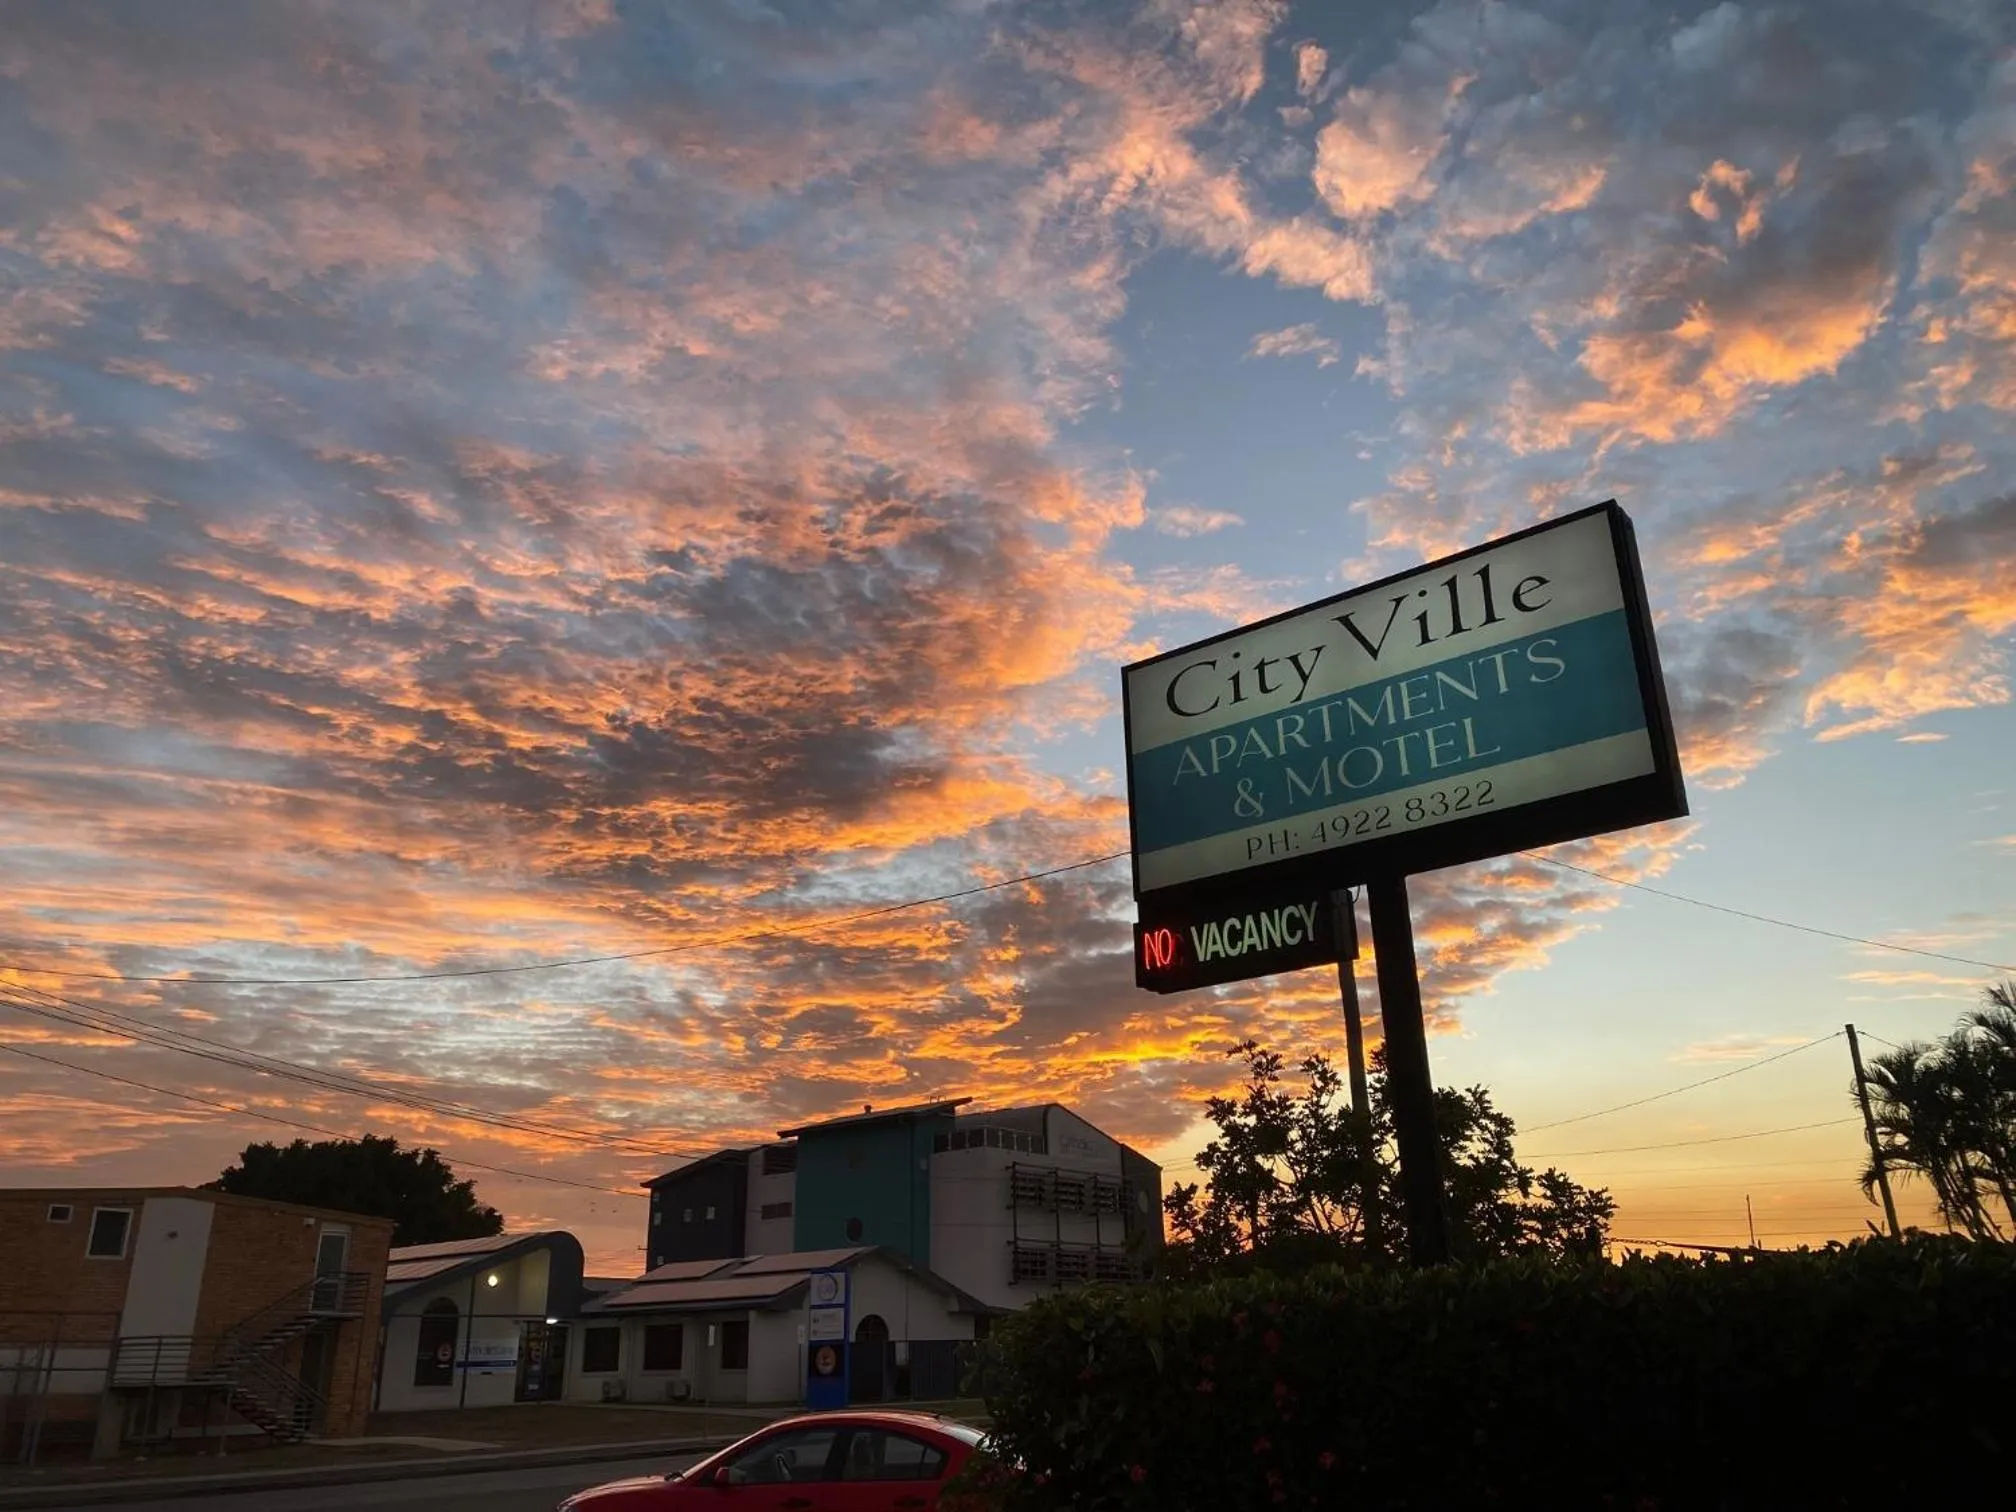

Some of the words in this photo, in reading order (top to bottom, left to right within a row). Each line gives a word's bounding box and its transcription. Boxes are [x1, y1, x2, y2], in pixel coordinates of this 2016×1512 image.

[1173, 639, 1566, 786] APARTMENTS
[1234, 778, 1265, 818] &
[1286, 716, 1501, 804] MOTEL
[1247, 831, 1300, 860] PH:
[1311, 805, 1393, 843] 4922
[1405, 781, 1495, 823] 8322
[1143, 928, 1172, 969] NO
[1191, 900, 1319, 963] VACANCY
